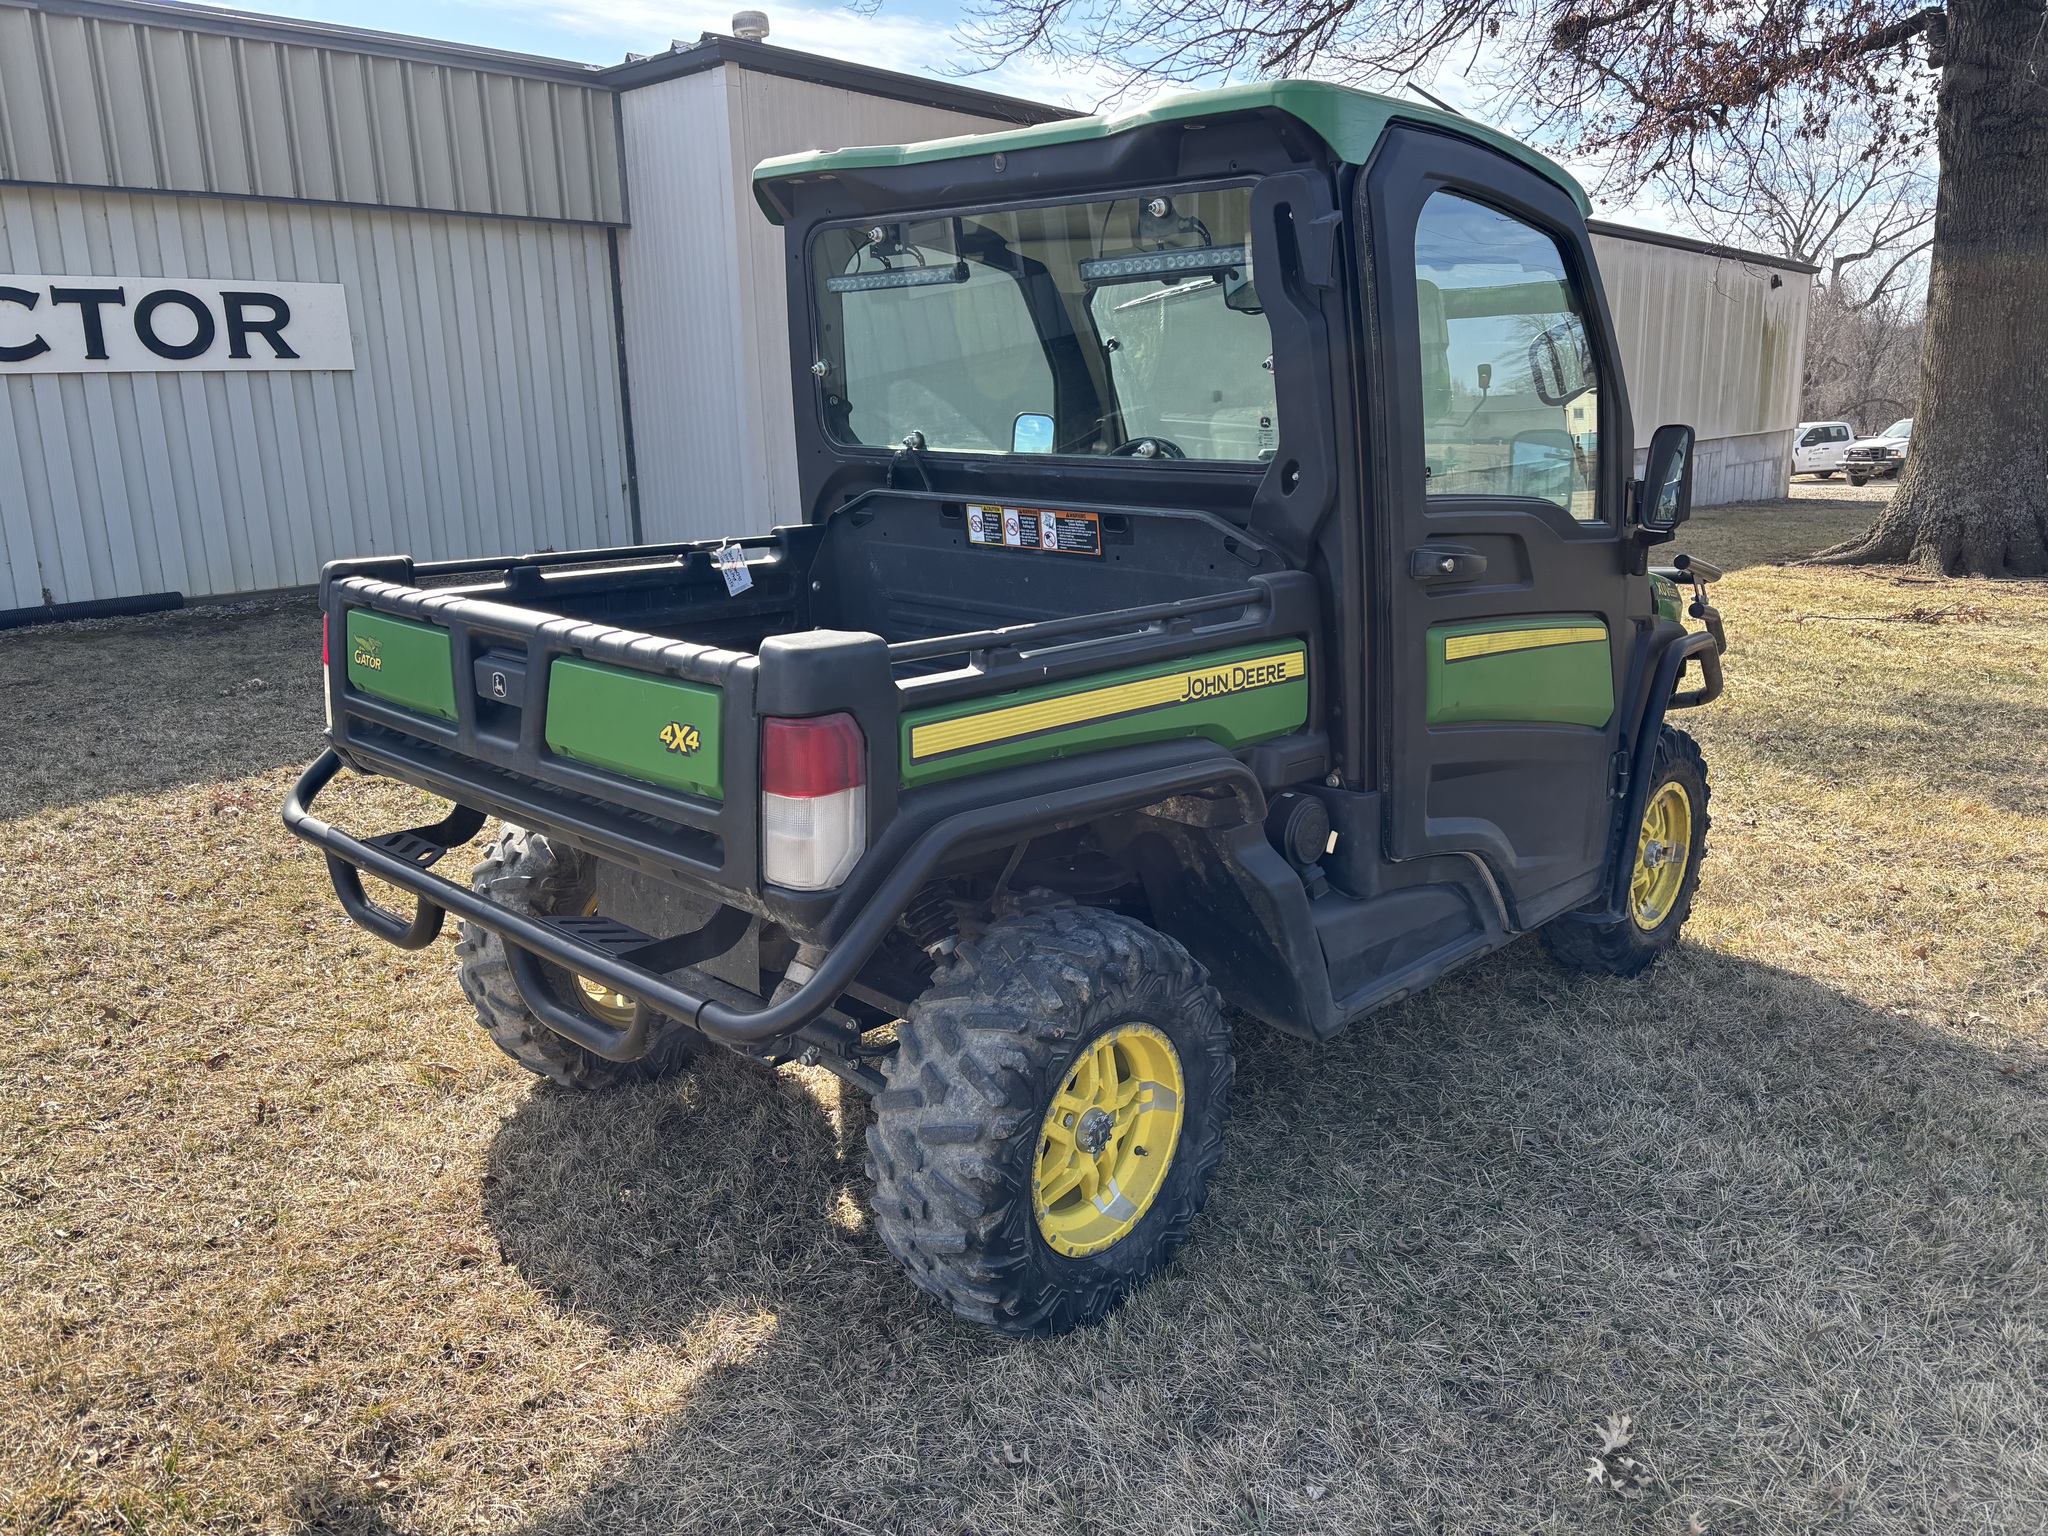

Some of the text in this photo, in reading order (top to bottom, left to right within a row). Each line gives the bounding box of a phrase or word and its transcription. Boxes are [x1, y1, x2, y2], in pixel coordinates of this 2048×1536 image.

[0, 285, 301, 362] CTOR
[354, 649, 382, 672] GATOR
[1181, 662, 1286, 699] JOHN DEERE
